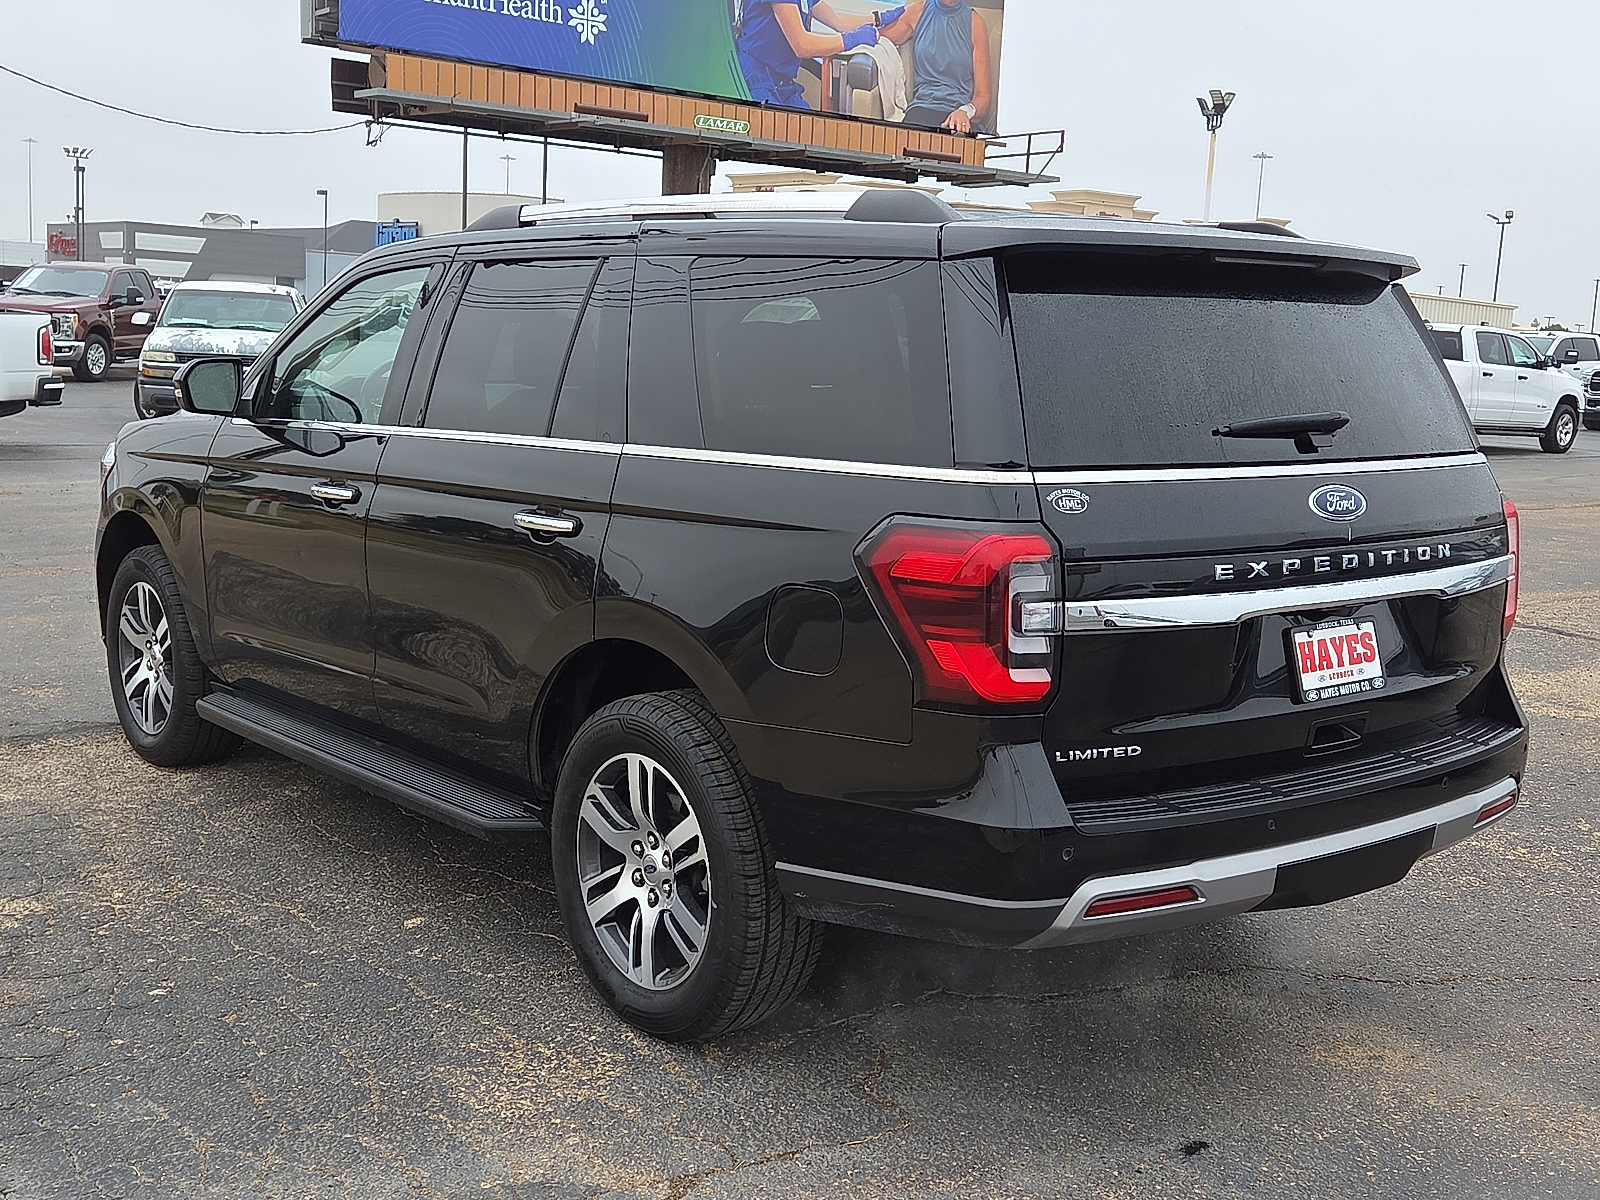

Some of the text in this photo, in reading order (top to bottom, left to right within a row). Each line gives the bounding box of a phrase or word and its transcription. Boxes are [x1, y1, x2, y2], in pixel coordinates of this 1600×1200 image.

[698, 117, 745, 131] LAMAR
[1058, 497, 1083, 510] HMC
[1326, 491, 1357, 512] Ford
[1213, 543, 1452, 581] EXPEDITION
[1298, 631, 1377, 674] HAYES
[1319, 687, 1340, 700] HAYES
[1339, 683, 1361, 696] MOTOR
[1361, 680, 1372, 692] CO.
[1055, 745, 1142, 763] LIMITED
